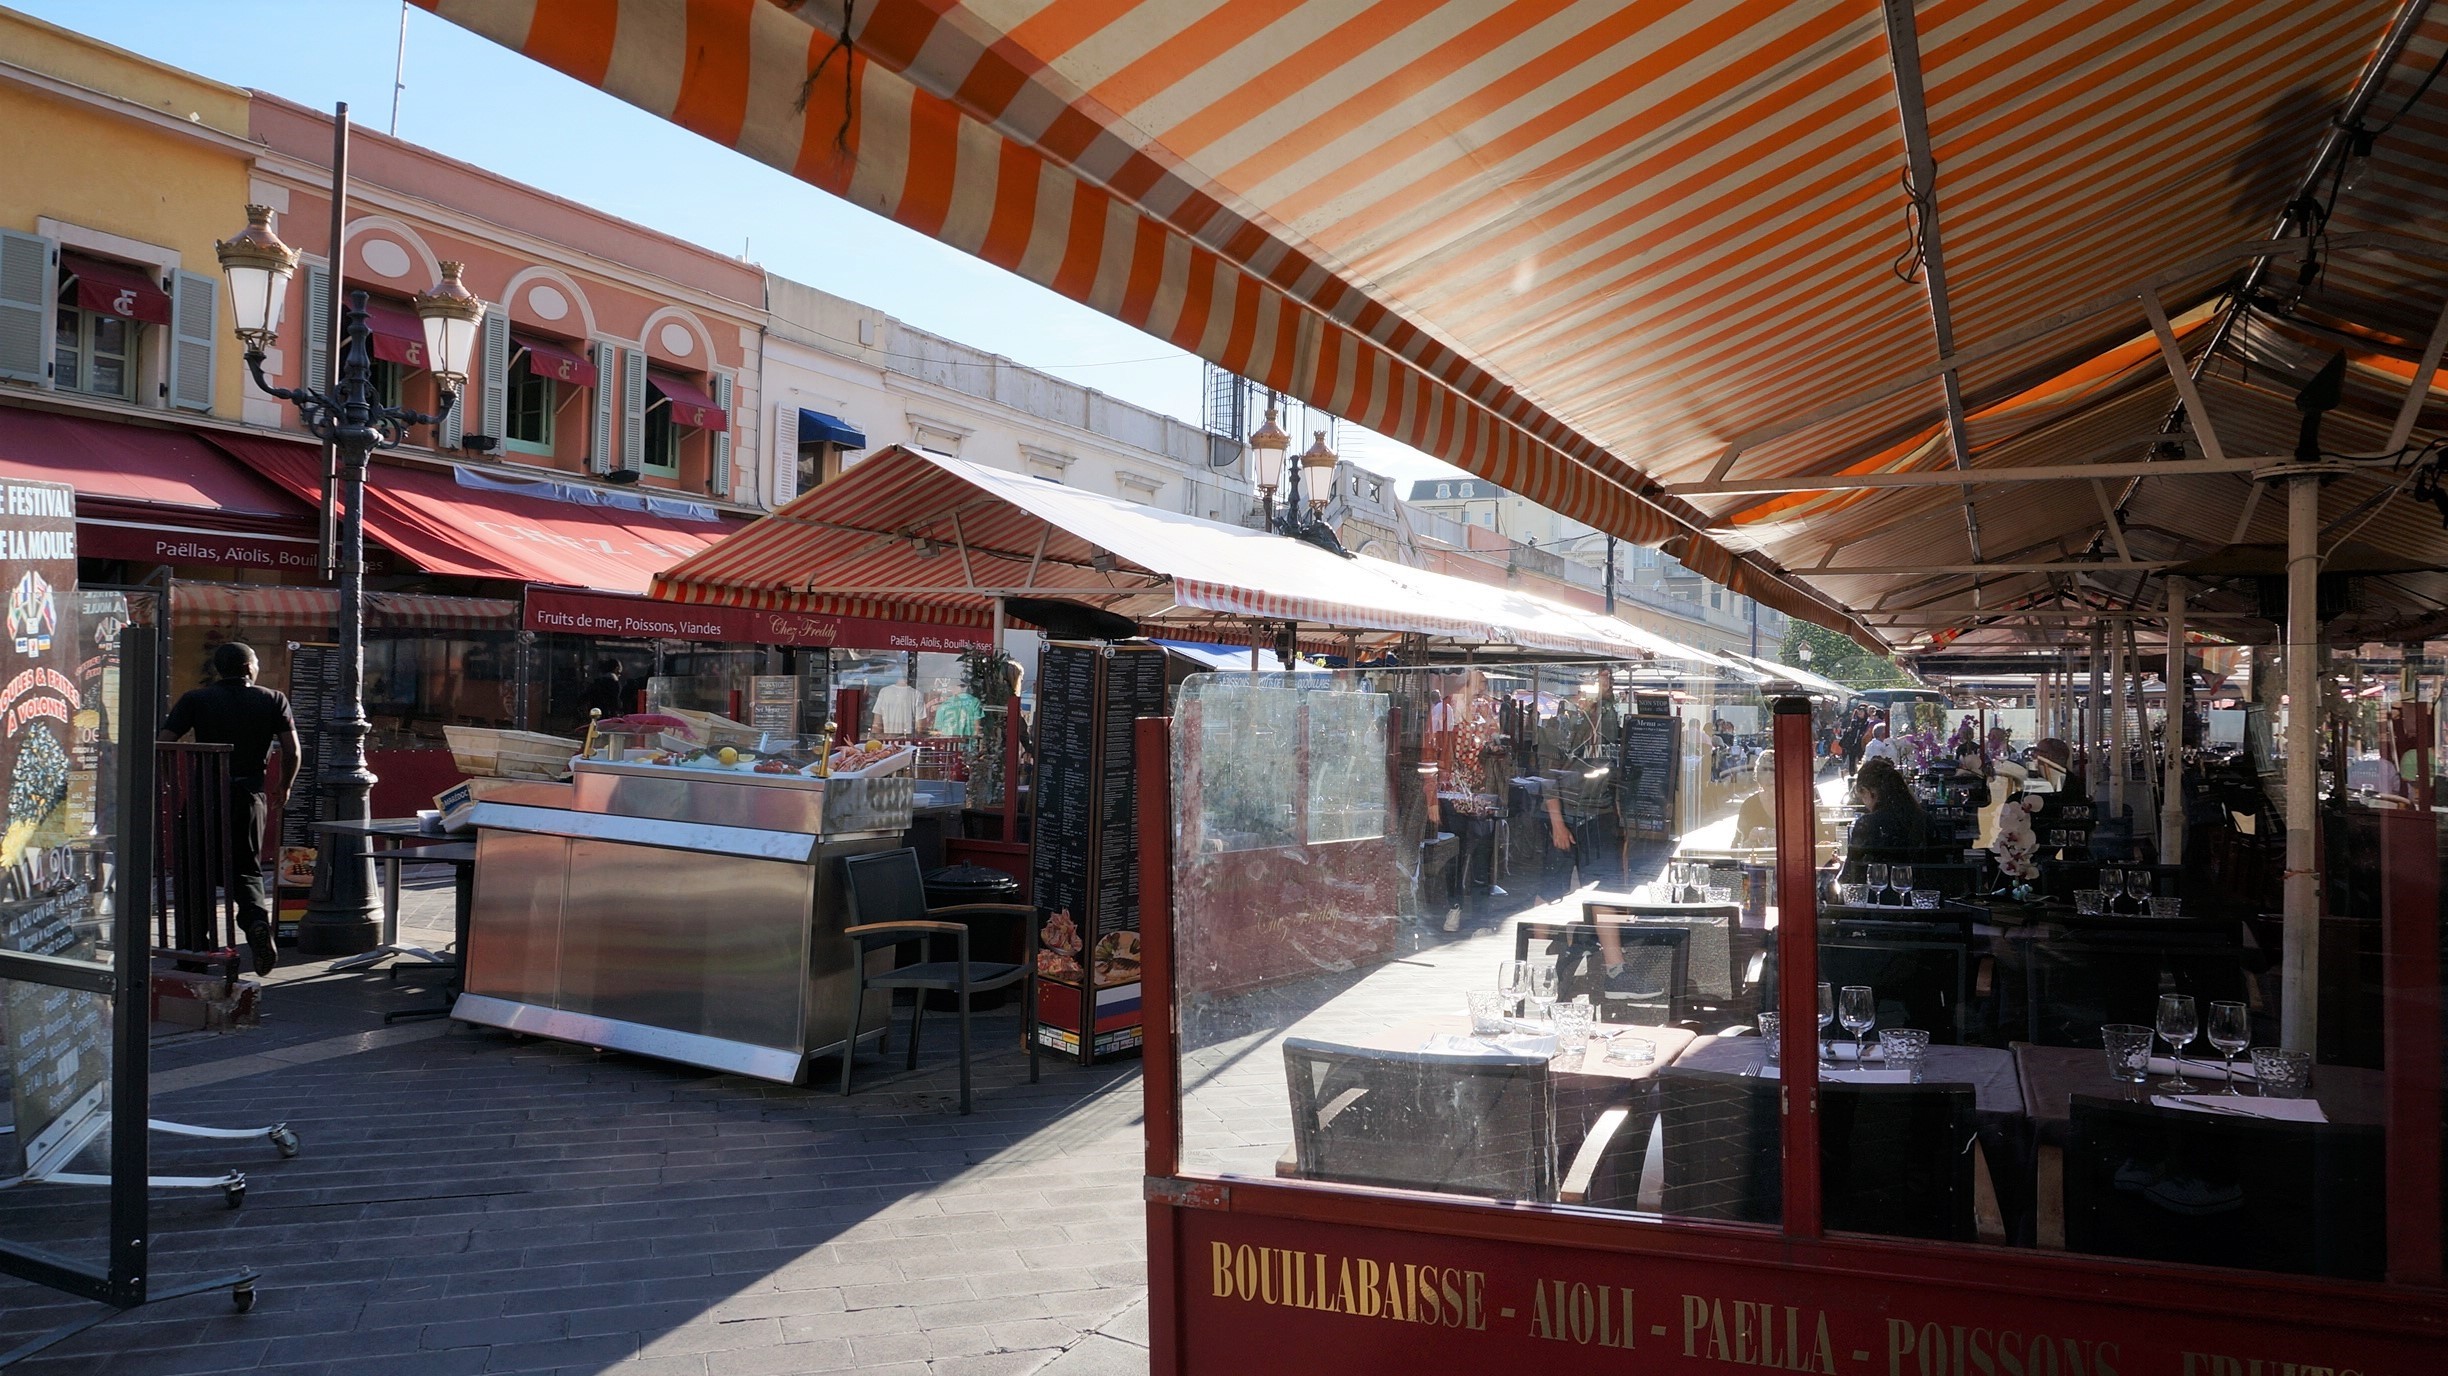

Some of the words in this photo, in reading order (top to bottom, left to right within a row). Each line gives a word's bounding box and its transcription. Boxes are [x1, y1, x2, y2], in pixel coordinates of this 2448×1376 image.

[8, 485, 72, 518] FESTIVAL
[8, 530, 27, 560] LA
[28, 530, 75, 560] MOULE
[155, 541, 221, 562] Paëllas,
[224, 547, 275, 565] Aïolis,
[537, 610, 574, 627] Fruits
[577, 613, 593, 628] de
[595, 618, 622, 631] mer,
[625, 618, 678, 635] Poissons,
[680, 621, 722, 635] Viandes
[769, 614, 798, 643] Chez
[799, 618, 838, 645] Freddy
[890, 635, 919, 648] Paëllas,
[0, 668, 34, 719] OULES
[35, 667, 47, 687] &
[1209, 1240, 1488, 1332] BOUILLABAISSE
[1528, 1277, 1637, 1350] AIOLI
[1681, 1293, 1838, 1376] PAELLA
